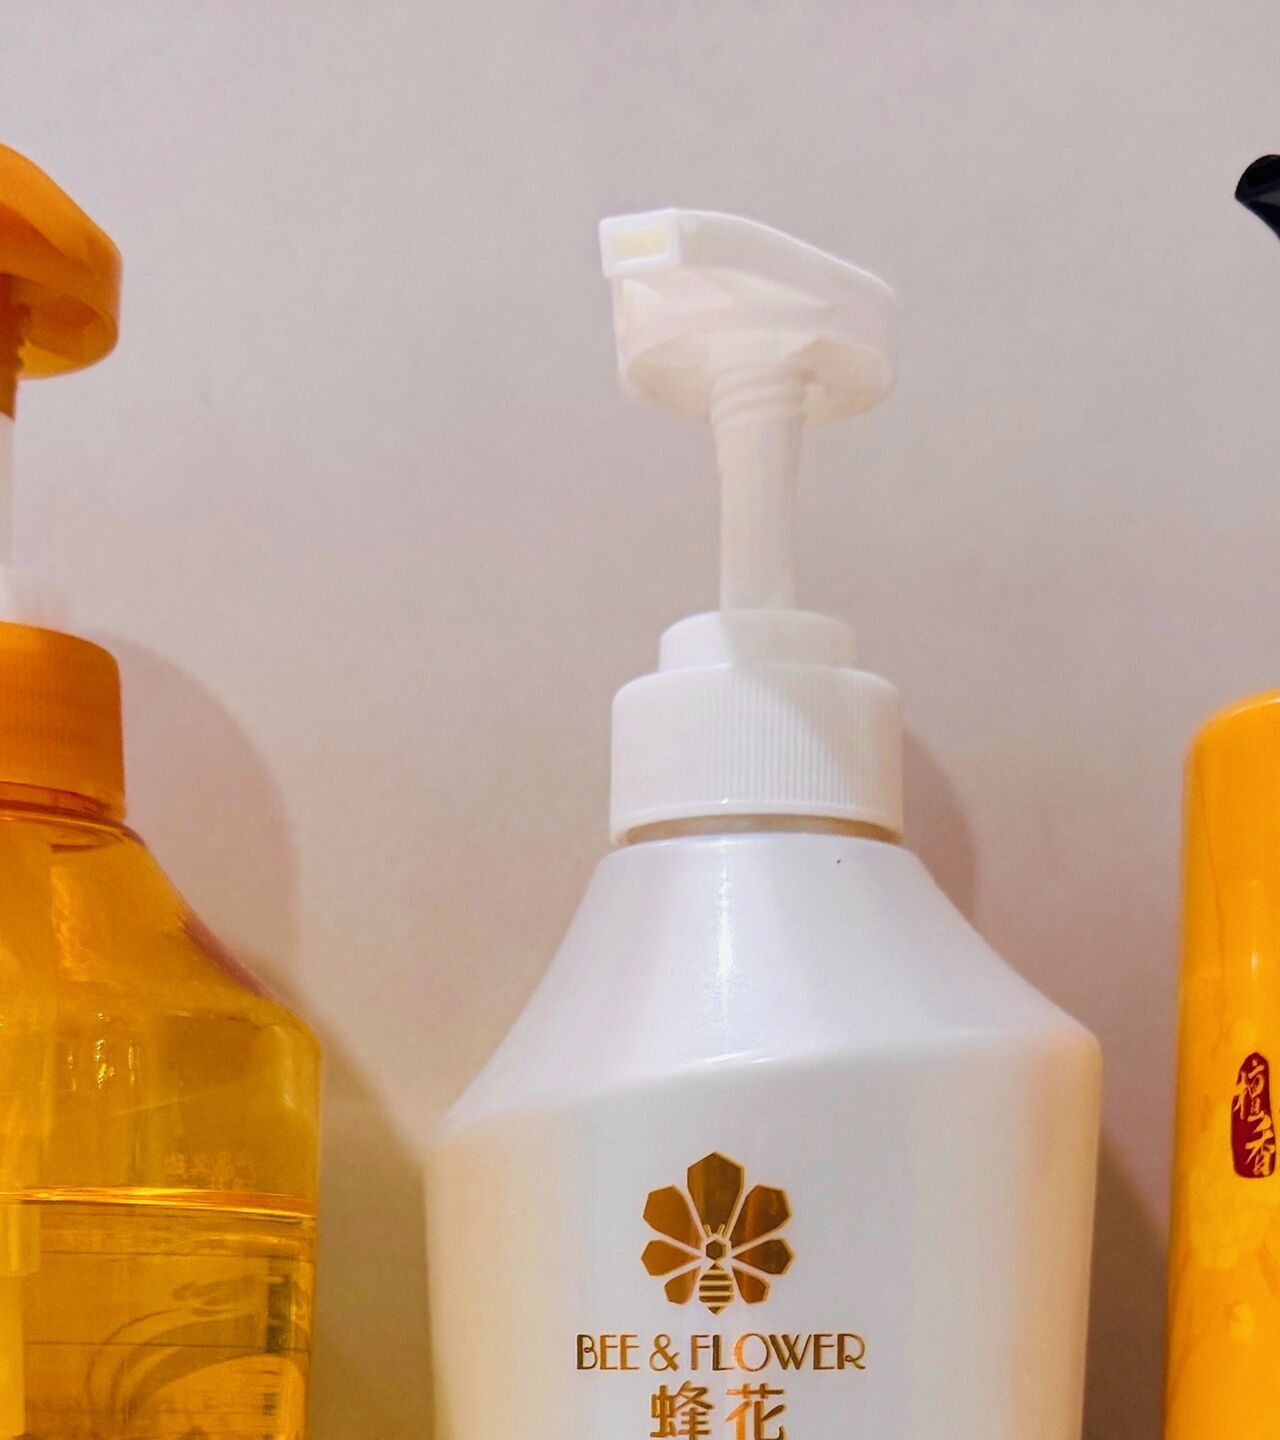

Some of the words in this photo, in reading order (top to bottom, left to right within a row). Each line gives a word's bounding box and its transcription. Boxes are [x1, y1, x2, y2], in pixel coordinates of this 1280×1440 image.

[575, 1333, 641, 1371] BEE
[649, 1333, 680, 1371] &
[690, 1332, 866, 1372] FLOWER
